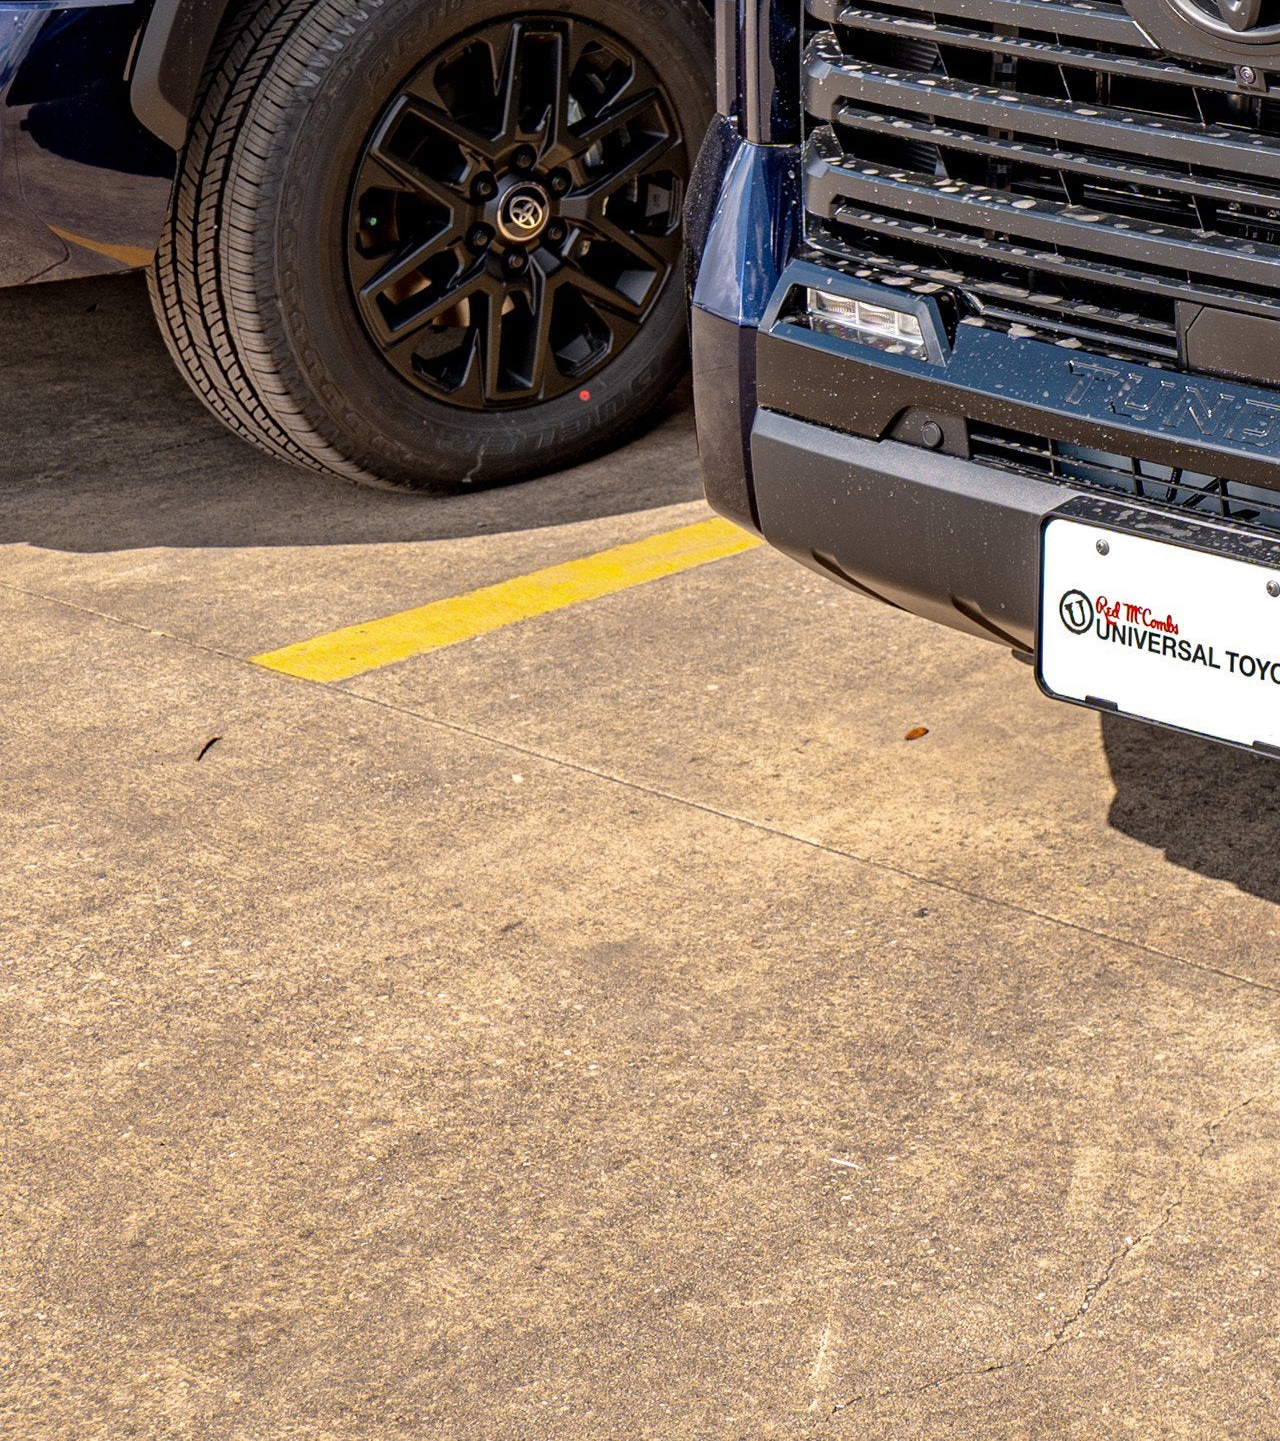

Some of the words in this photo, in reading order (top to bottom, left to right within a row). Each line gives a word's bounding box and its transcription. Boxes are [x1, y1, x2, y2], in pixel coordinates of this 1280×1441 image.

[1095, 595, 1121, 623] Red
[1123, 602, 1179, 635] McCombs
[1096, 617, 1221, 669] UNIVERSAL
